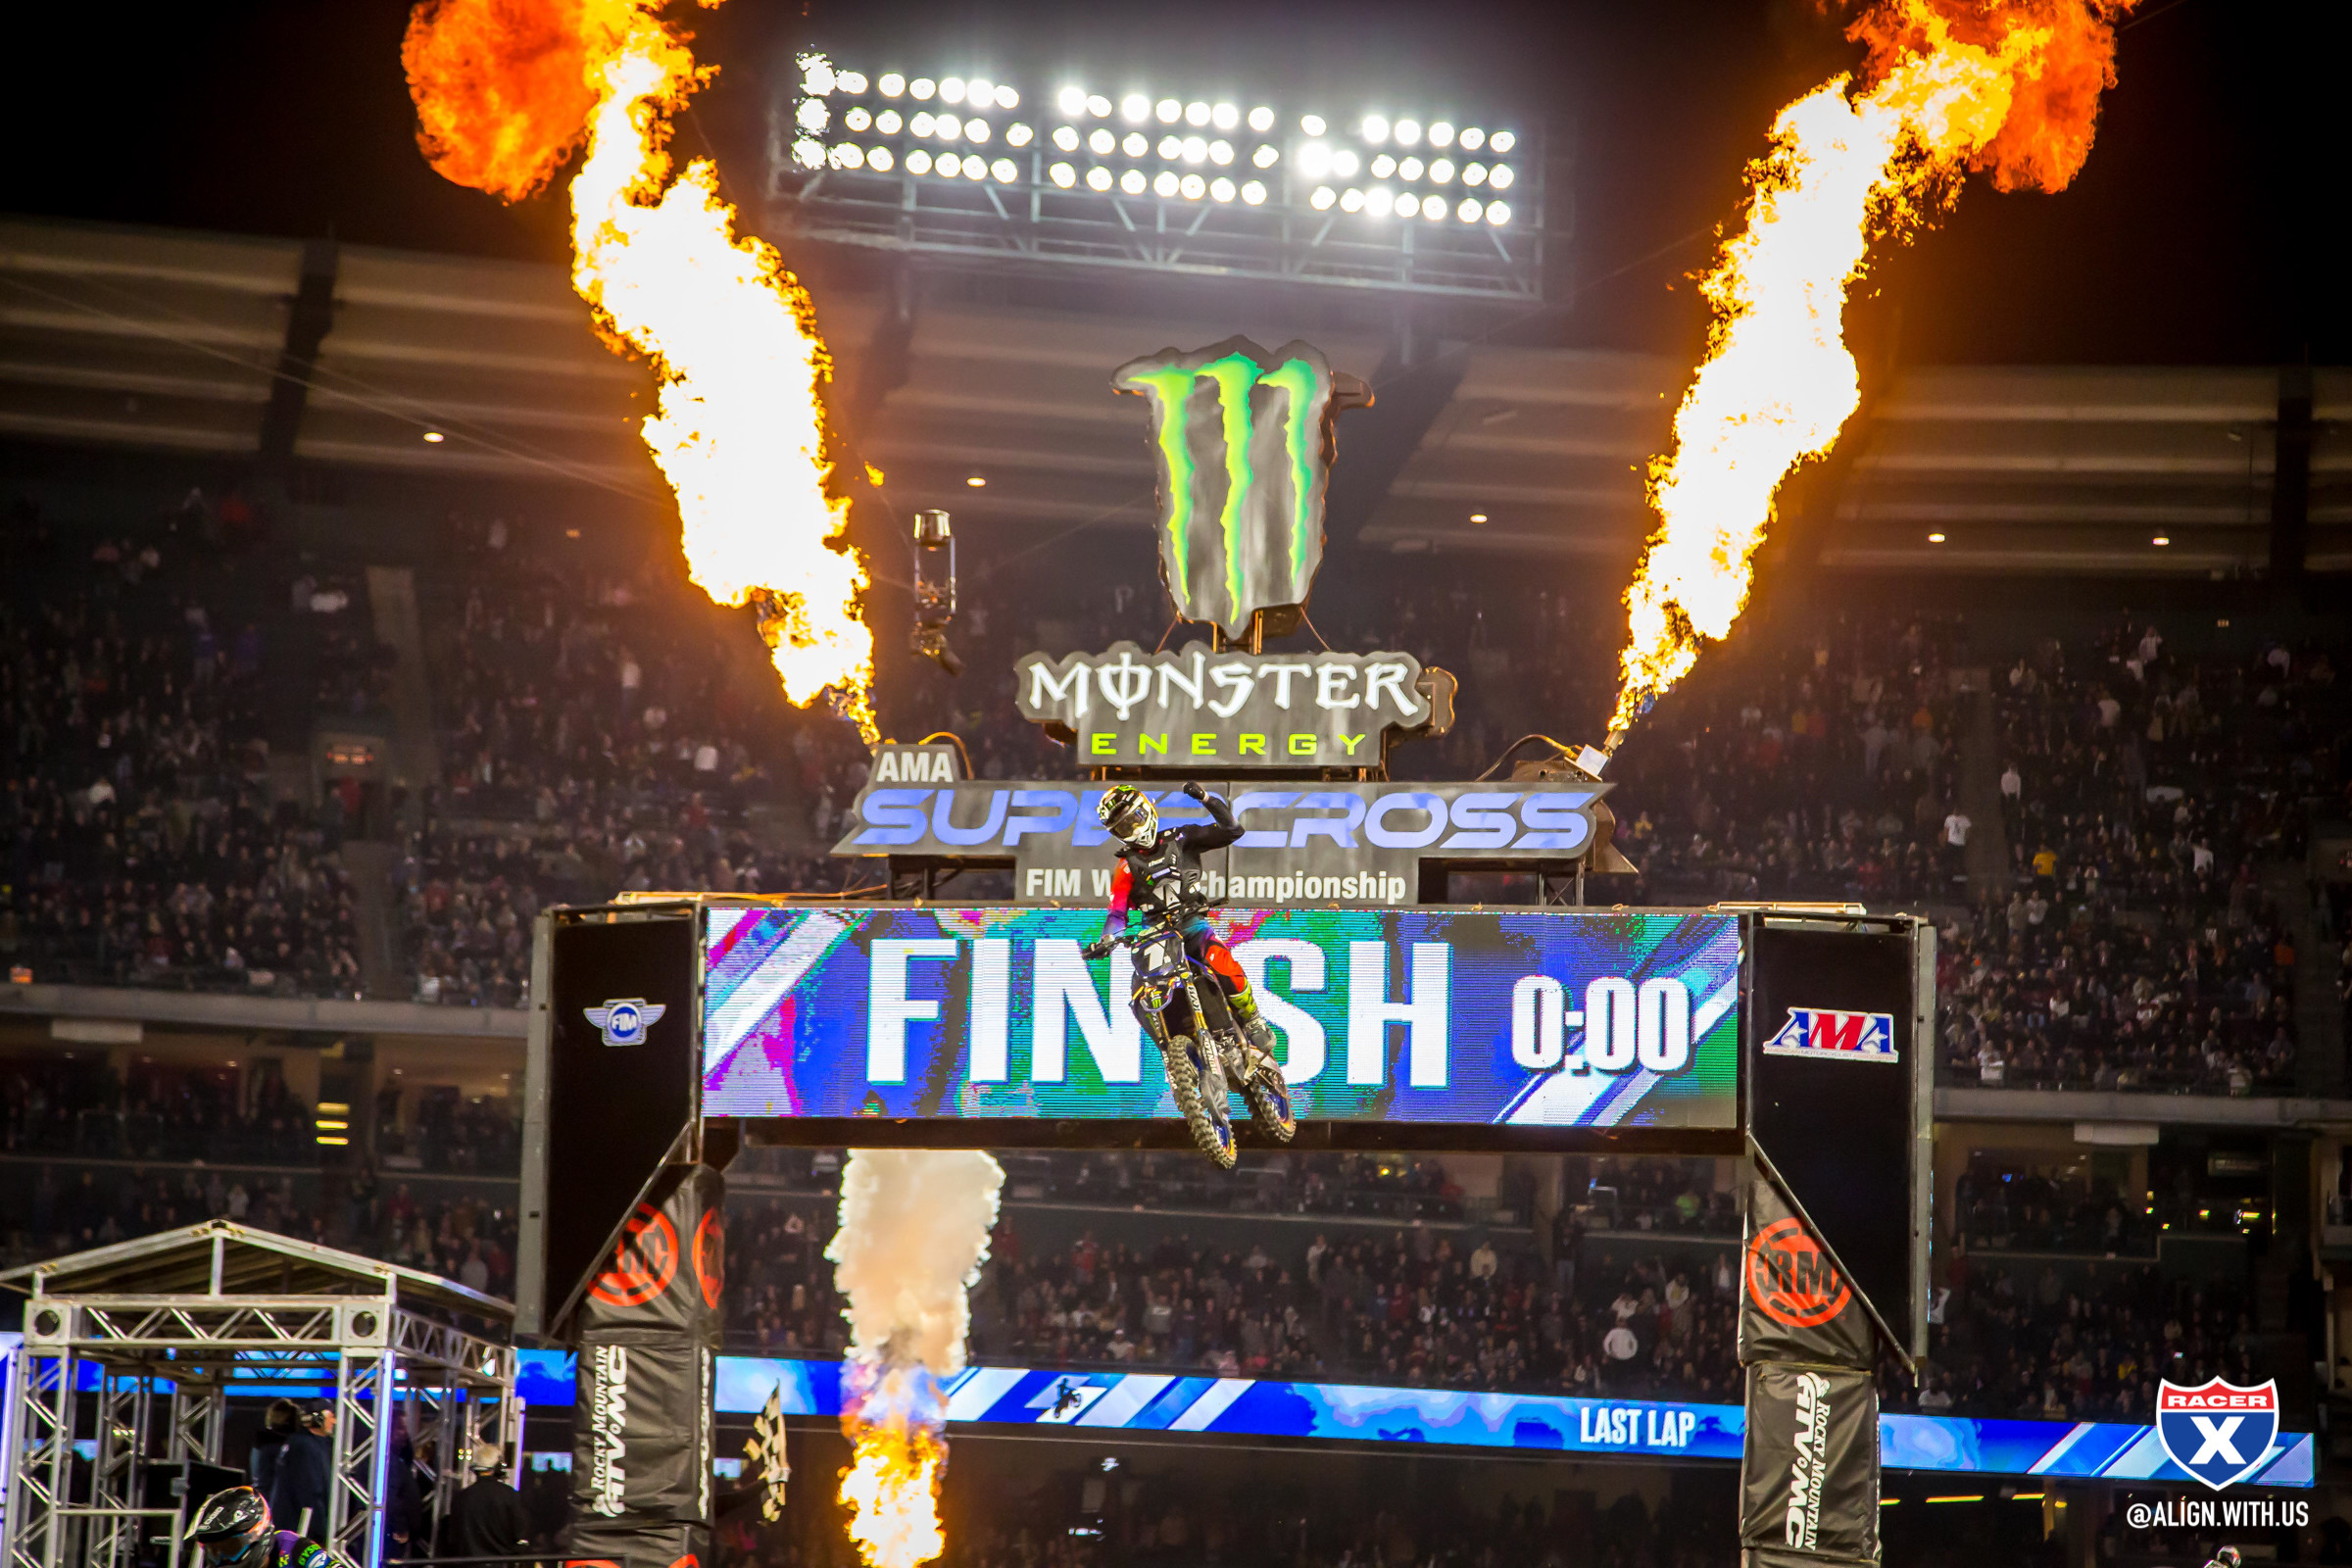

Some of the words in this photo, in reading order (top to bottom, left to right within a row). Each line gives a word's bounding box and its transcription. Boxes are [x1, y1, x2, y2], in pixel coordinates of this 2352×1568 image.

[1028, 651, 1419, 721] MONSTER
[876, 751, 955, 783] AMA
[1090, 732, 1367, 757] ENERGY
[1026, 868, 1081, 898] FIM
[612, 1012, 638, 1032] FIM
[865, 937, 1450, 1088] FINSH
[1511, 974, 1690, 1073] 0:00
[1770, 1010, 1893, 1054] AMA
[591, 1346, 610, 1435] MOUNTAIN
[1580, 1406, 1642, 1446] LAST
[1646, 1409, 1696, 1448] LAP
[1813, 1399, 1831, 1458] ROCKY
[591, 1437, 607, 1490] ROCKY
[1804, 1457, 1827, 1552] MOUNTAIN
